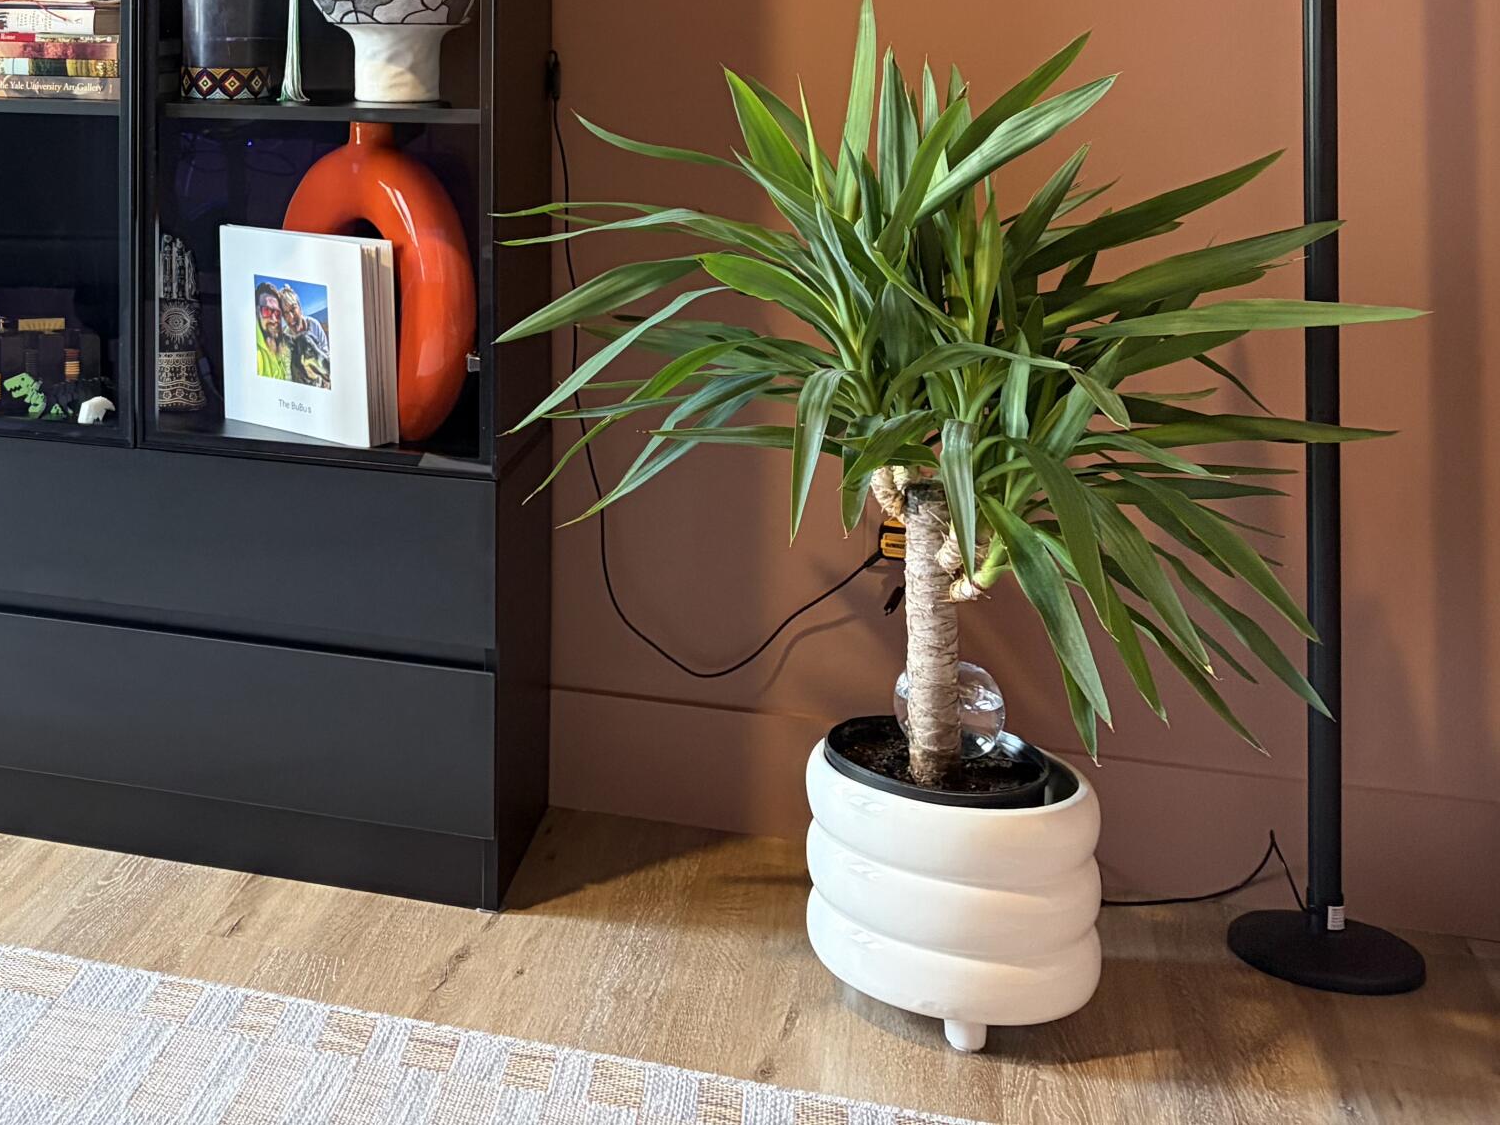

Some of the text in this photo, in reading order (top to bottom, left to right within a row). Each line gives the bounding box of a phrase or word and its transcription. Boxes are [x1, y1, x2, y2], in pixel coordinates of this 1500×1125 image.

[10, 81, 25, 91] Yale
[26, 81, 62, 94] University
[63, 83, 75, 92] Art
[76, 83, 103, 95] Gallery
[278, 399, 290, 410] The
